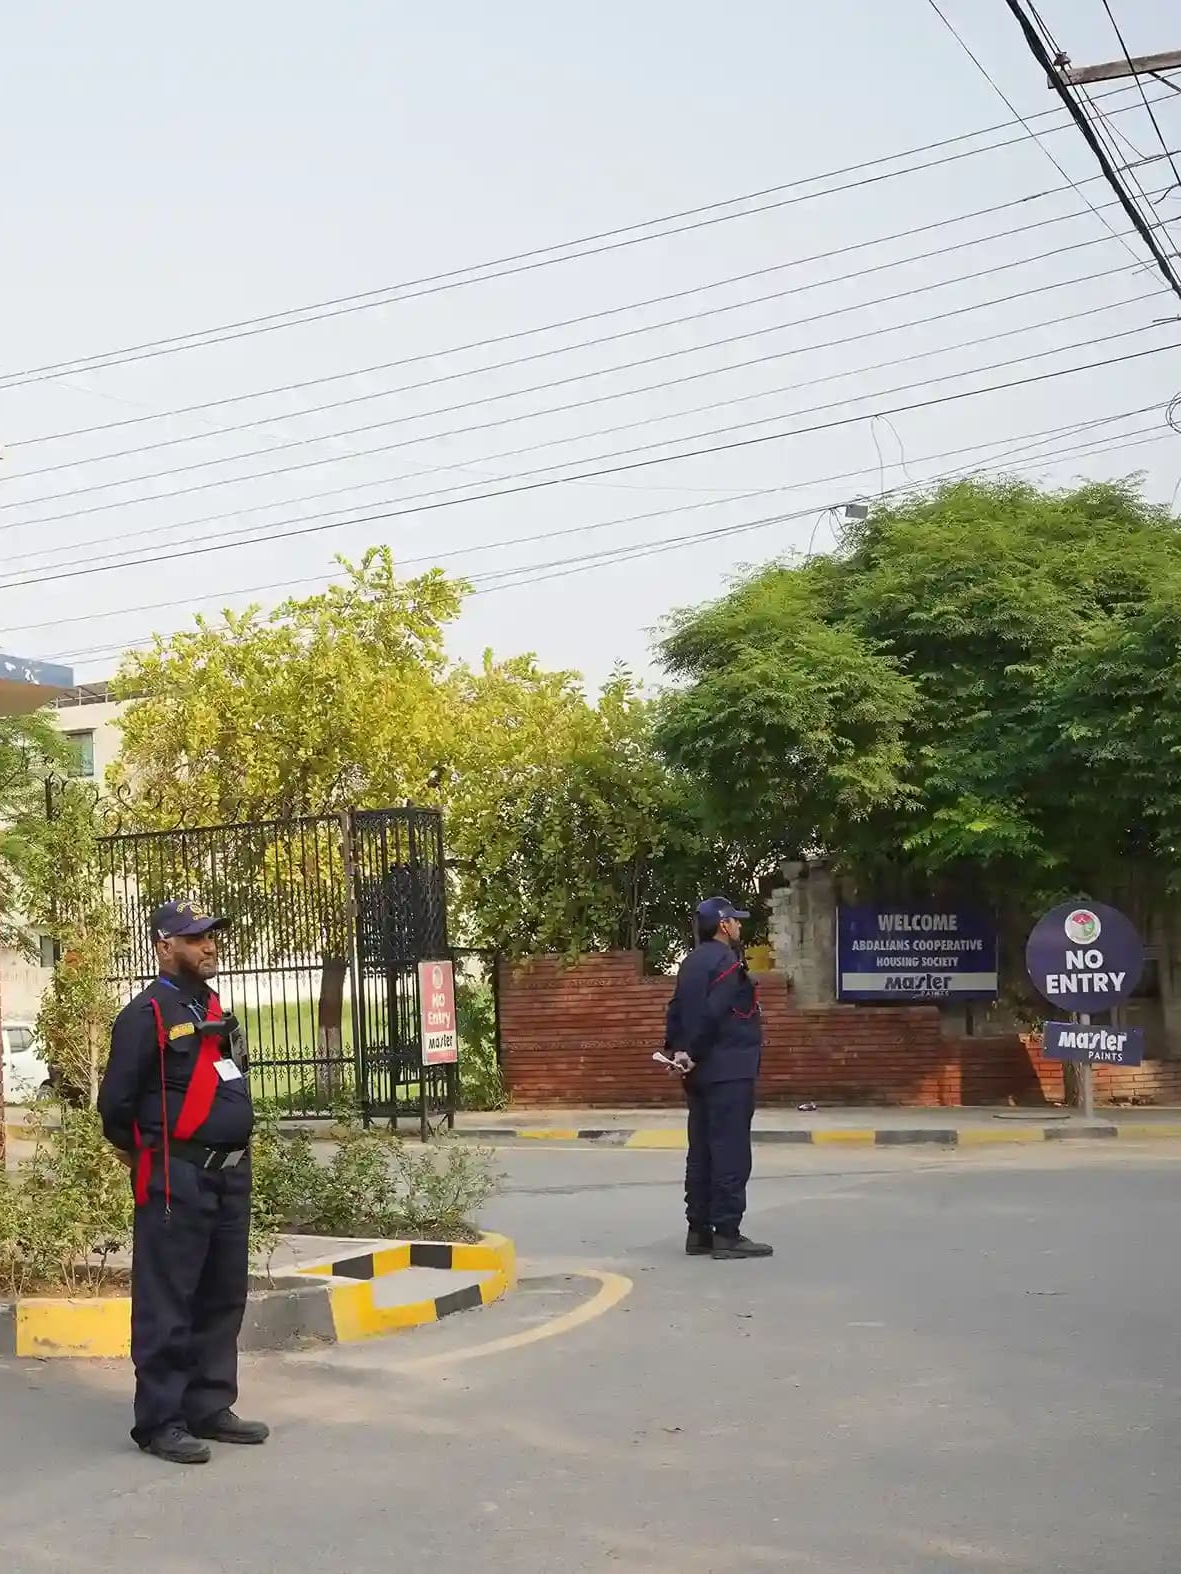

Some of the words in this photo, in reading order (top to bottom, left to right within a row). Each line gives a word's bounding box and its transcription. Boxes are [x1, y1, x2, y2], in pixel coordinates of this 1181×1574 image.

[877, 914, 958, 931] WELCOME
[852, 940, 910, 951] ABDALIANS
[913, 940, 983, 951] COOPERATIVE
[876, 957, 919, 967] HOUSING
[921, 957, 959, 967] SOCIETY
[1065, 949, 1104, 970] NO
[1045, 972, 1126, 994] ENTRY
[427, 1010, 451, 1029] Entry
[1088, 1051, 1123, 1062] PAINTS
